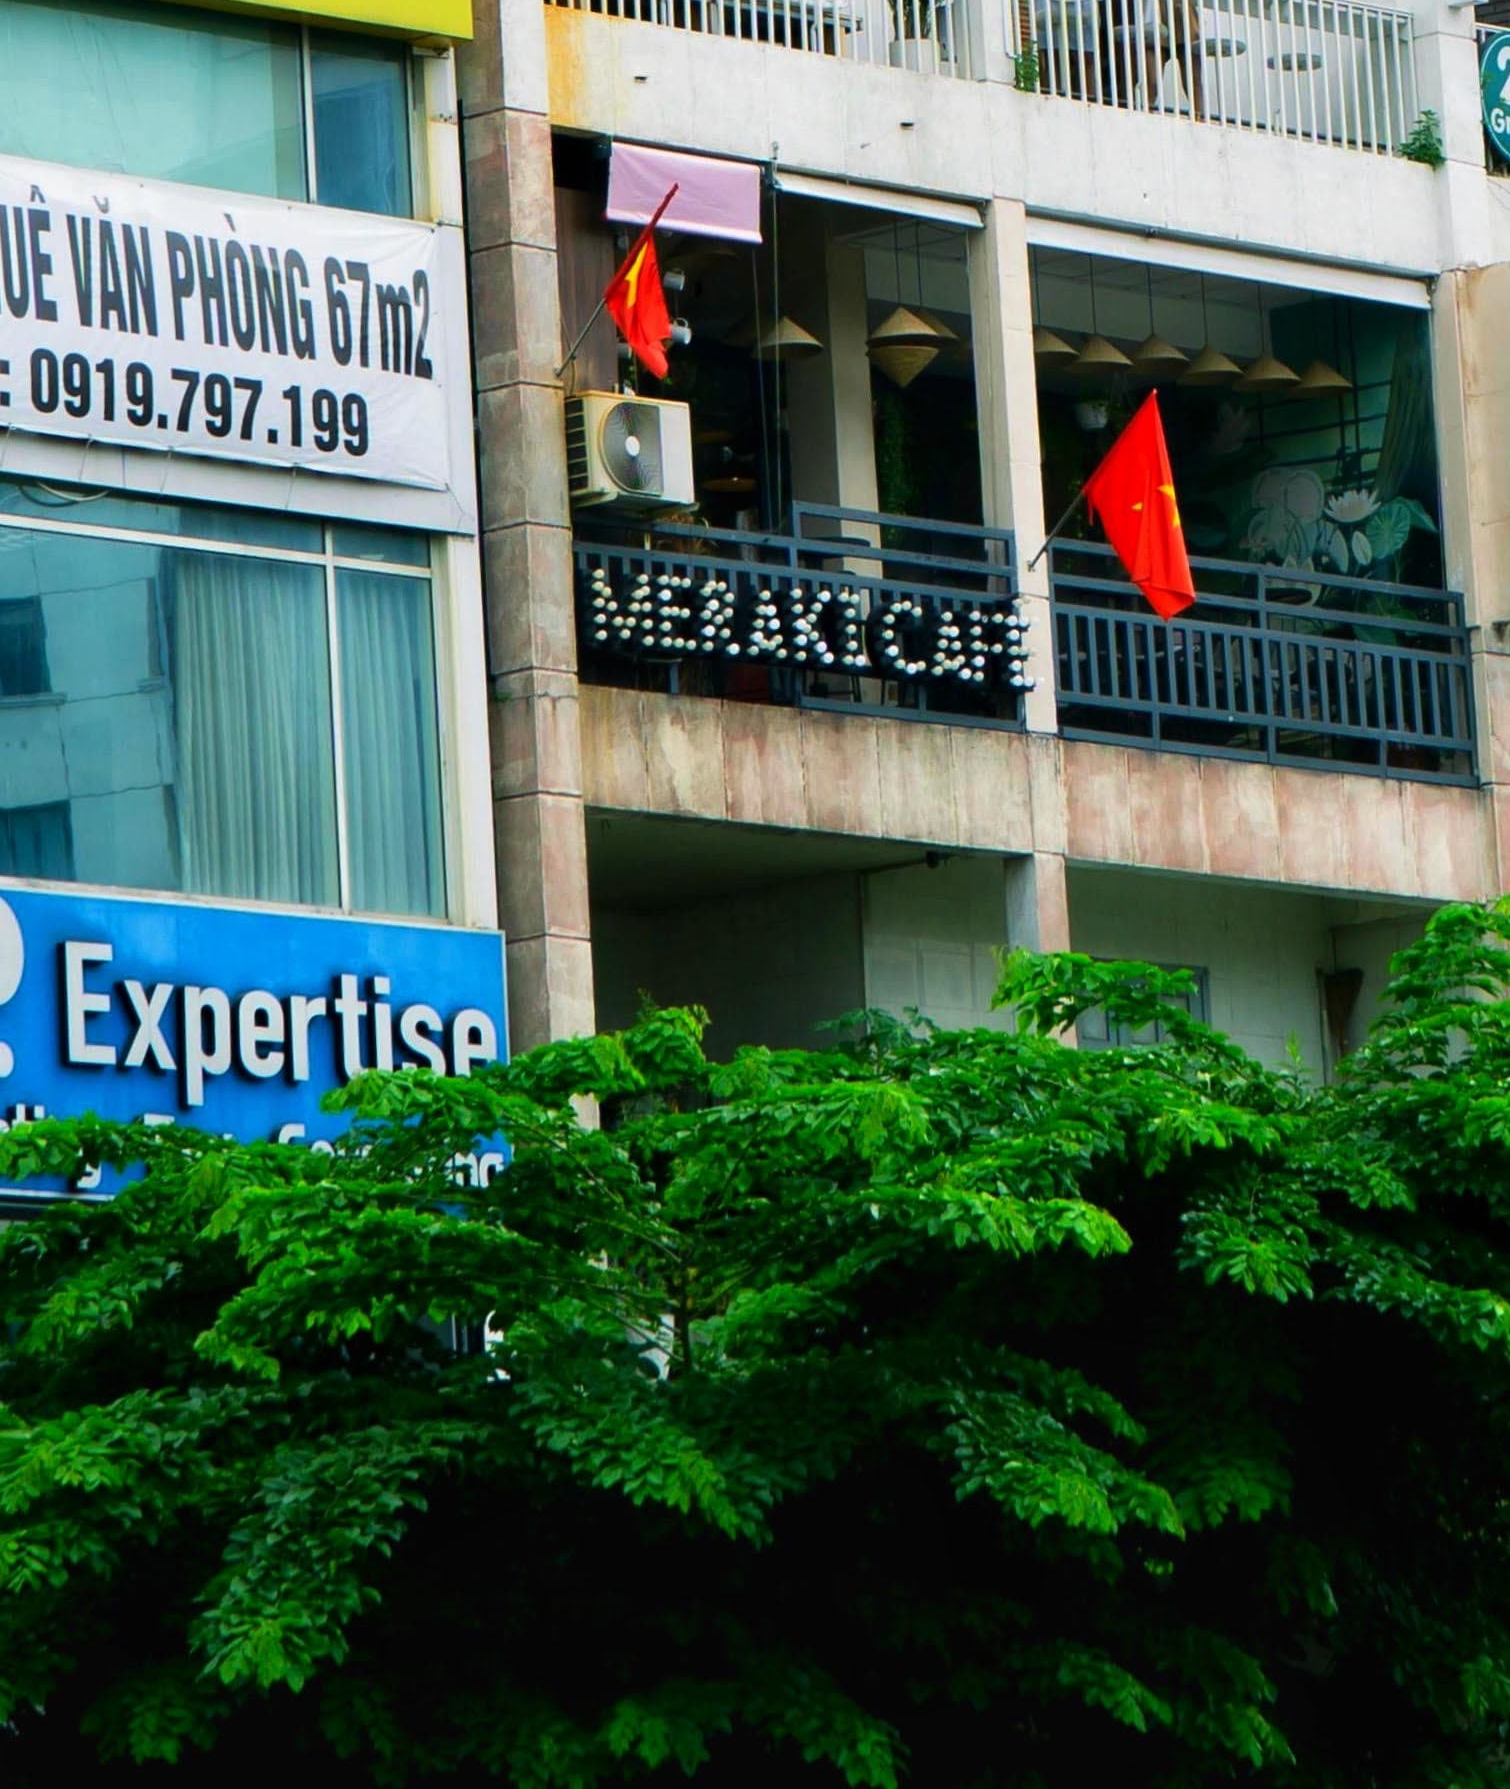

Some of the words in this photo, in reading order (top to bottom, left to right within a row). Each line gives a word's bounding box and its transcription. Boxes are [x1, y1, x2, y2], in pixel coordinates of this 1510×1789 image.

[0, 184, 59, 322] UÊ
[65, 194, 160, 338] VĂN
[164, 212, 317, 362] PHÒNG
[29, 347, 370, 458] 0919.797.199
[62, 940, 499, 1108] Expertise
